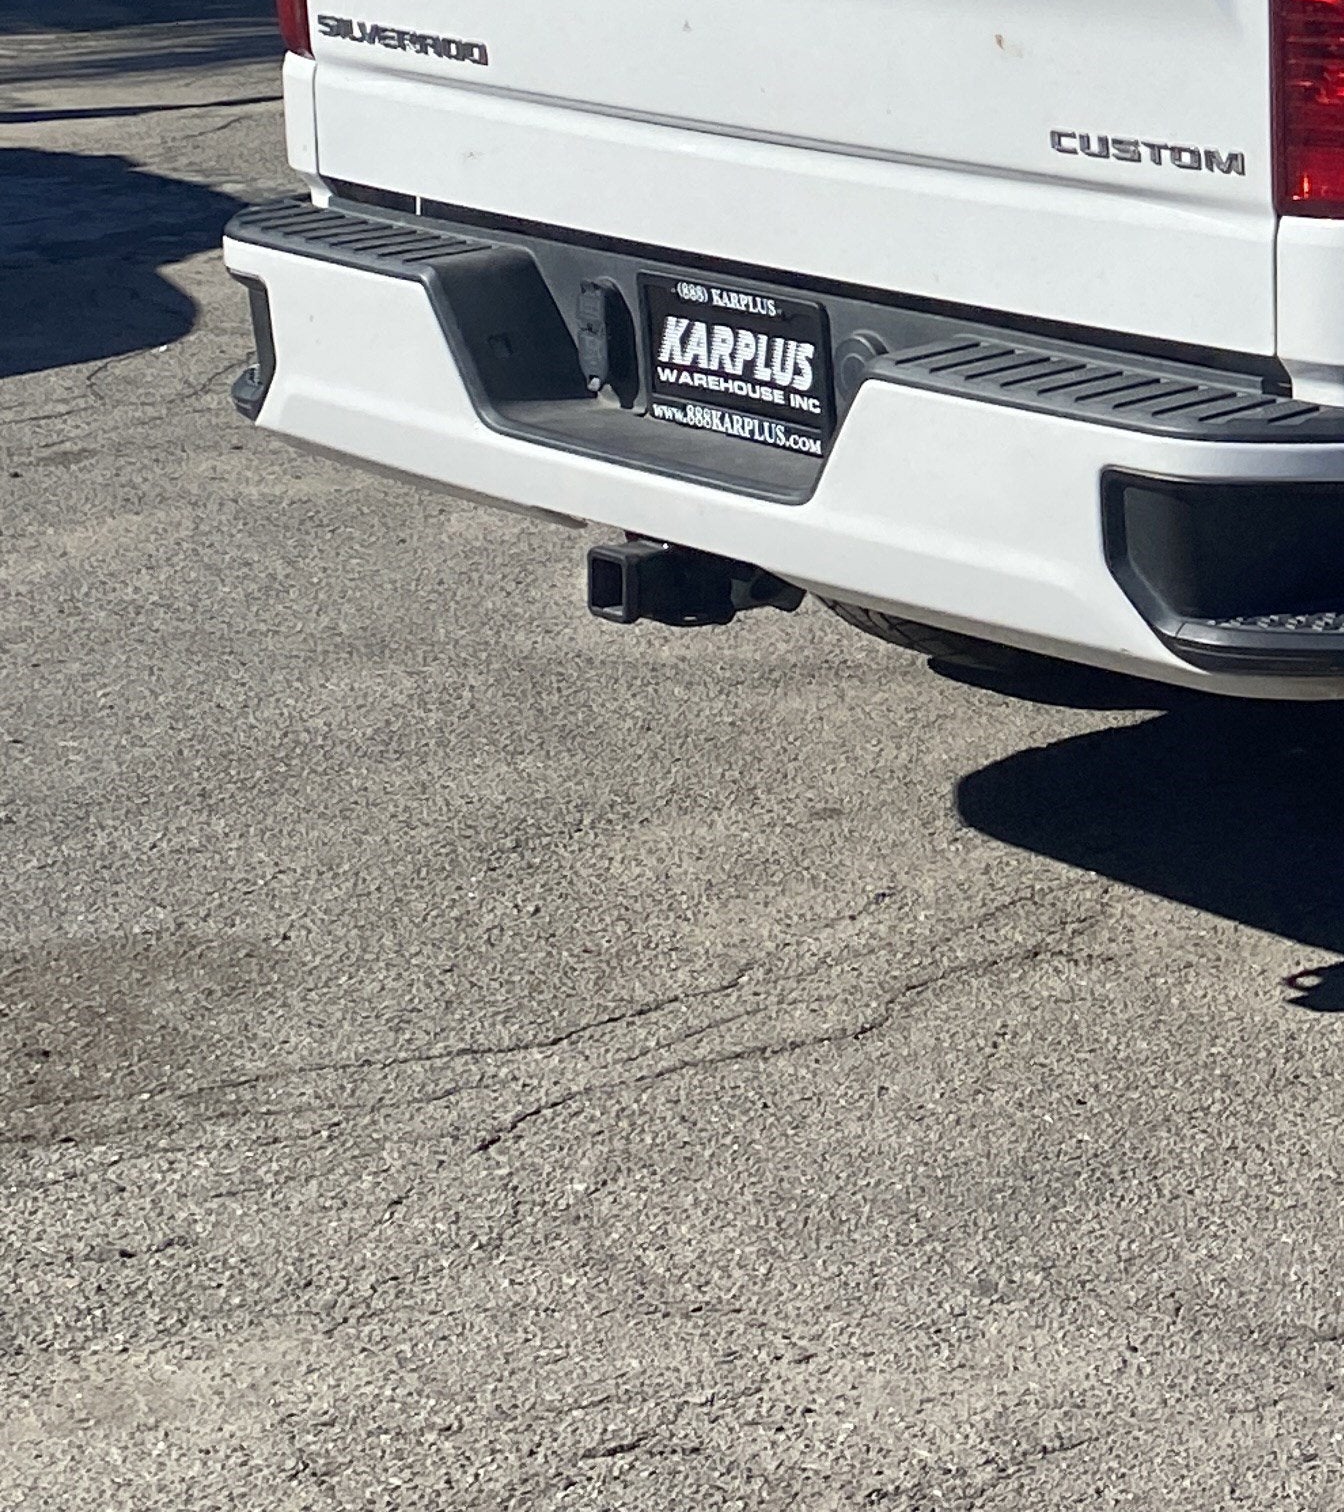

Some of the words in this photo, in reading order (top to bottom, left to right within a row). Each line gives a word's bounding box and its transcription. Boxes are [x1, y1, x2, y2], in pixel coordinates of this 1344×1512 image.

[317, 14, 489, 66] SILVERADO
[1050, 130, 1246, 176] CUSTOM
[676, 282, 709, 304] (888)
[711, 289, 776, 317] KARPLUS
[657, 316, 815, 391] KARPLUS
[656, 366, 786, 405] WAREHOUSE
[790, 393, 821, 414] INC
